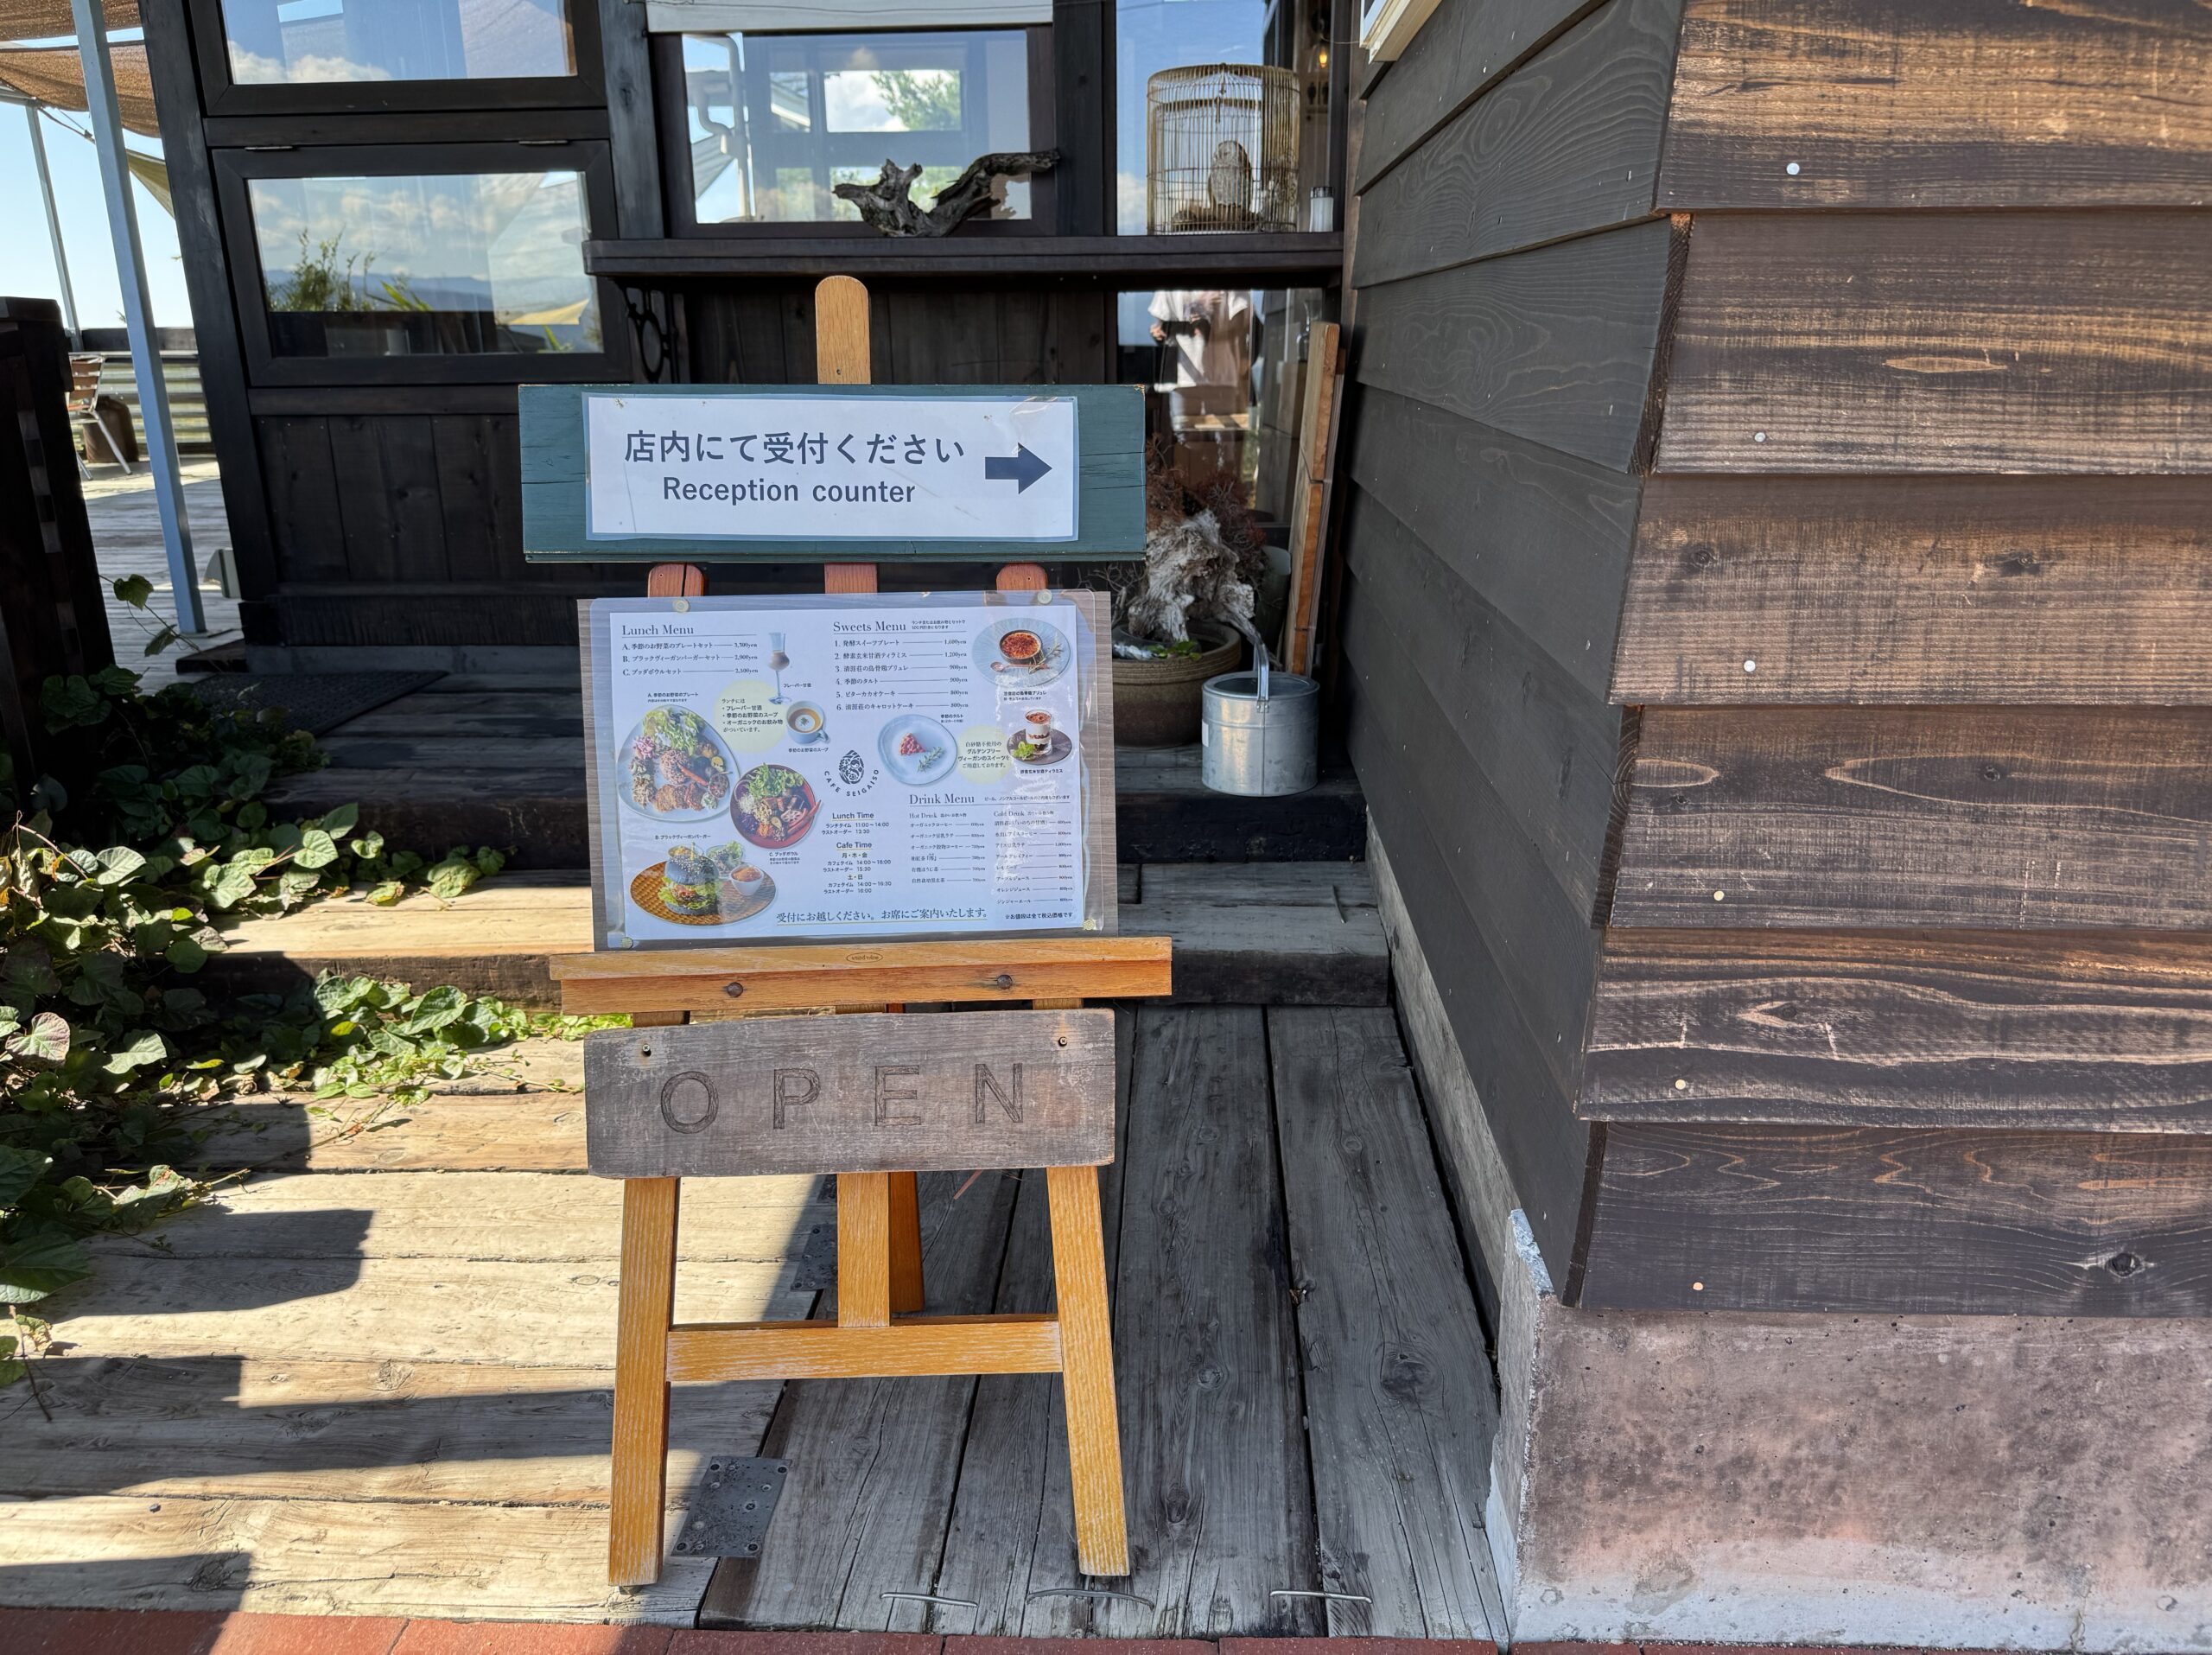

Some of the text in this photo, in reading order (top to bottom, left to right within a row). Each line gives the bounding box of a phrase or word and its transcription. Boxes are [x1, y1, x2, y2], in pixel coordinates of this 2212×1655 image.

[625, 430, 965, 466] 店内にて受付ください
[663, 476, 915, 506] Reception counter
[621, 624, 695, 635] Lunch Menu
[833, 621, 906, 632] Sweets Menu
[824, 769, 880, 797] CAFE SEIGAISO
[910, 793, 975, 805] Drink Menu
[776, 907, 988, 923] 受付にお越しください。 お席にご案内いたします。
[659, 1062, 1024, 1135] OPEN
